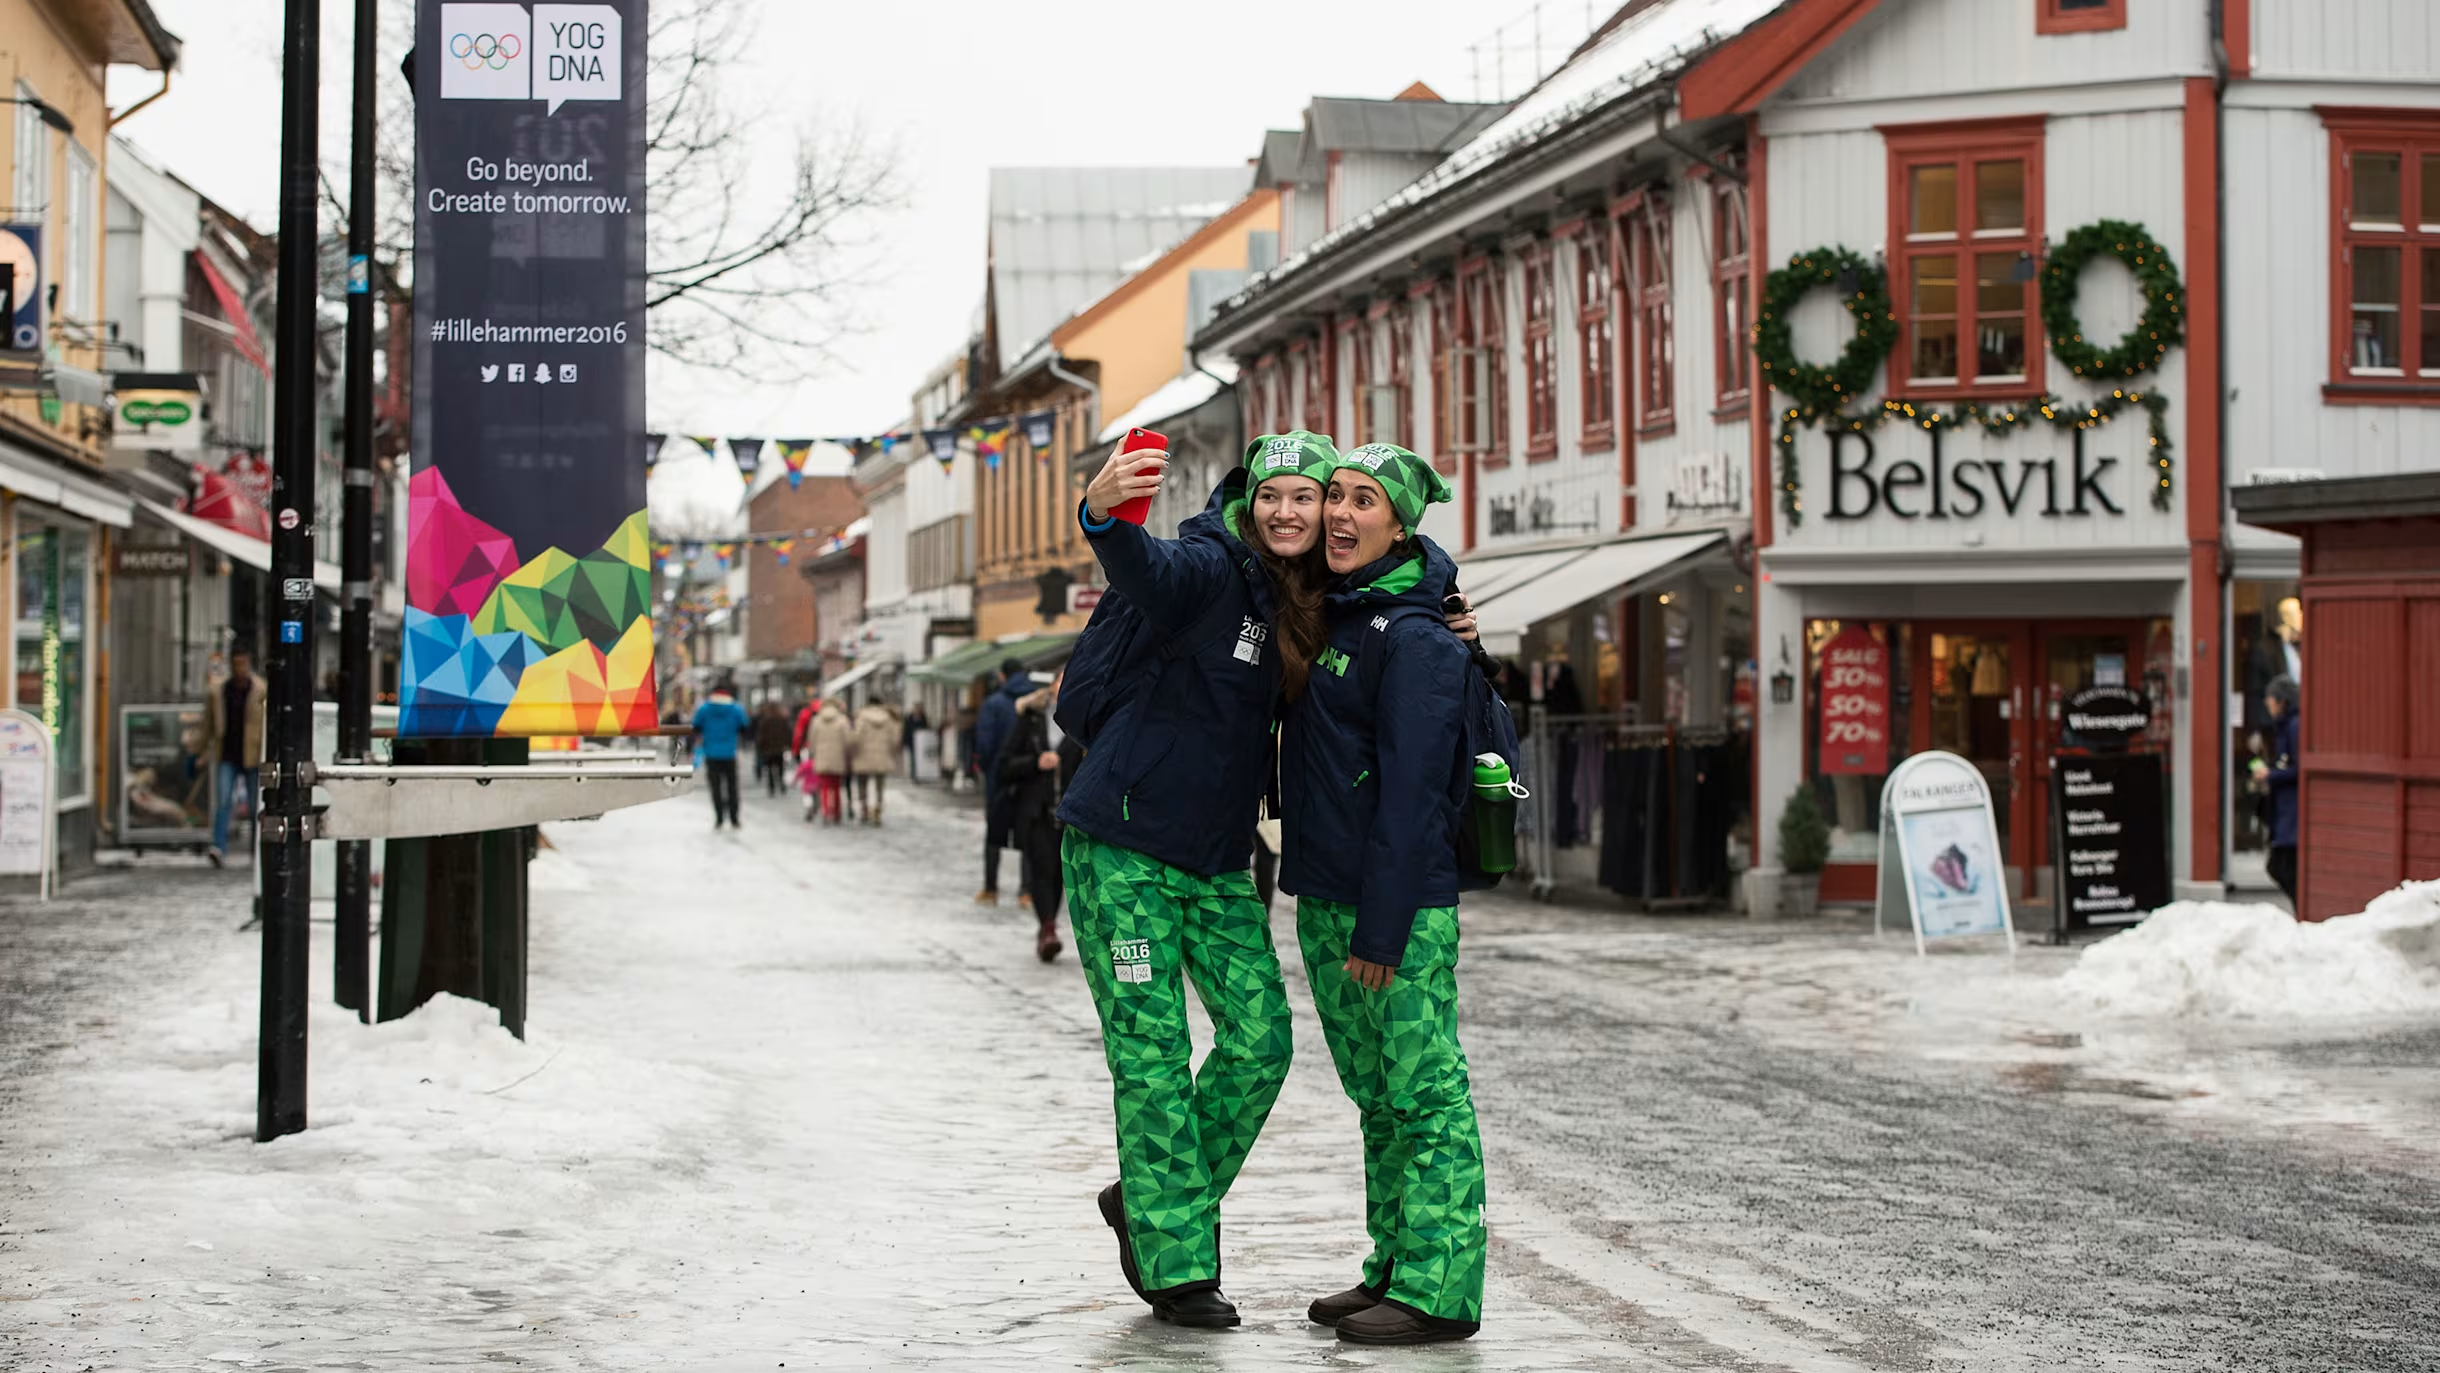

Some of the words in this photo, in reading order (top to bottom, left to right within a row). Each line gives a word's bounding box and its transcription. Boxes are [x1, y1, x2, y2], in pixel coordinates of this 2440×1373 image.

[549, 22, 605, 49] YOG
[549, 55, 605, 81] DNA
[467, 157, 499, 181] Go
[505, 158, 593, 187] beyond.
[428, 188, 506, 213] Create
[513, 191, 631, 214] tomorrow.
[431, 319, 627, 344] #lillehammer2016
[1822, 427, 2125, 520] Belsvik
[1370, 614, 1390, 633] HH
[1111, 944, 1150, 960] 2016
